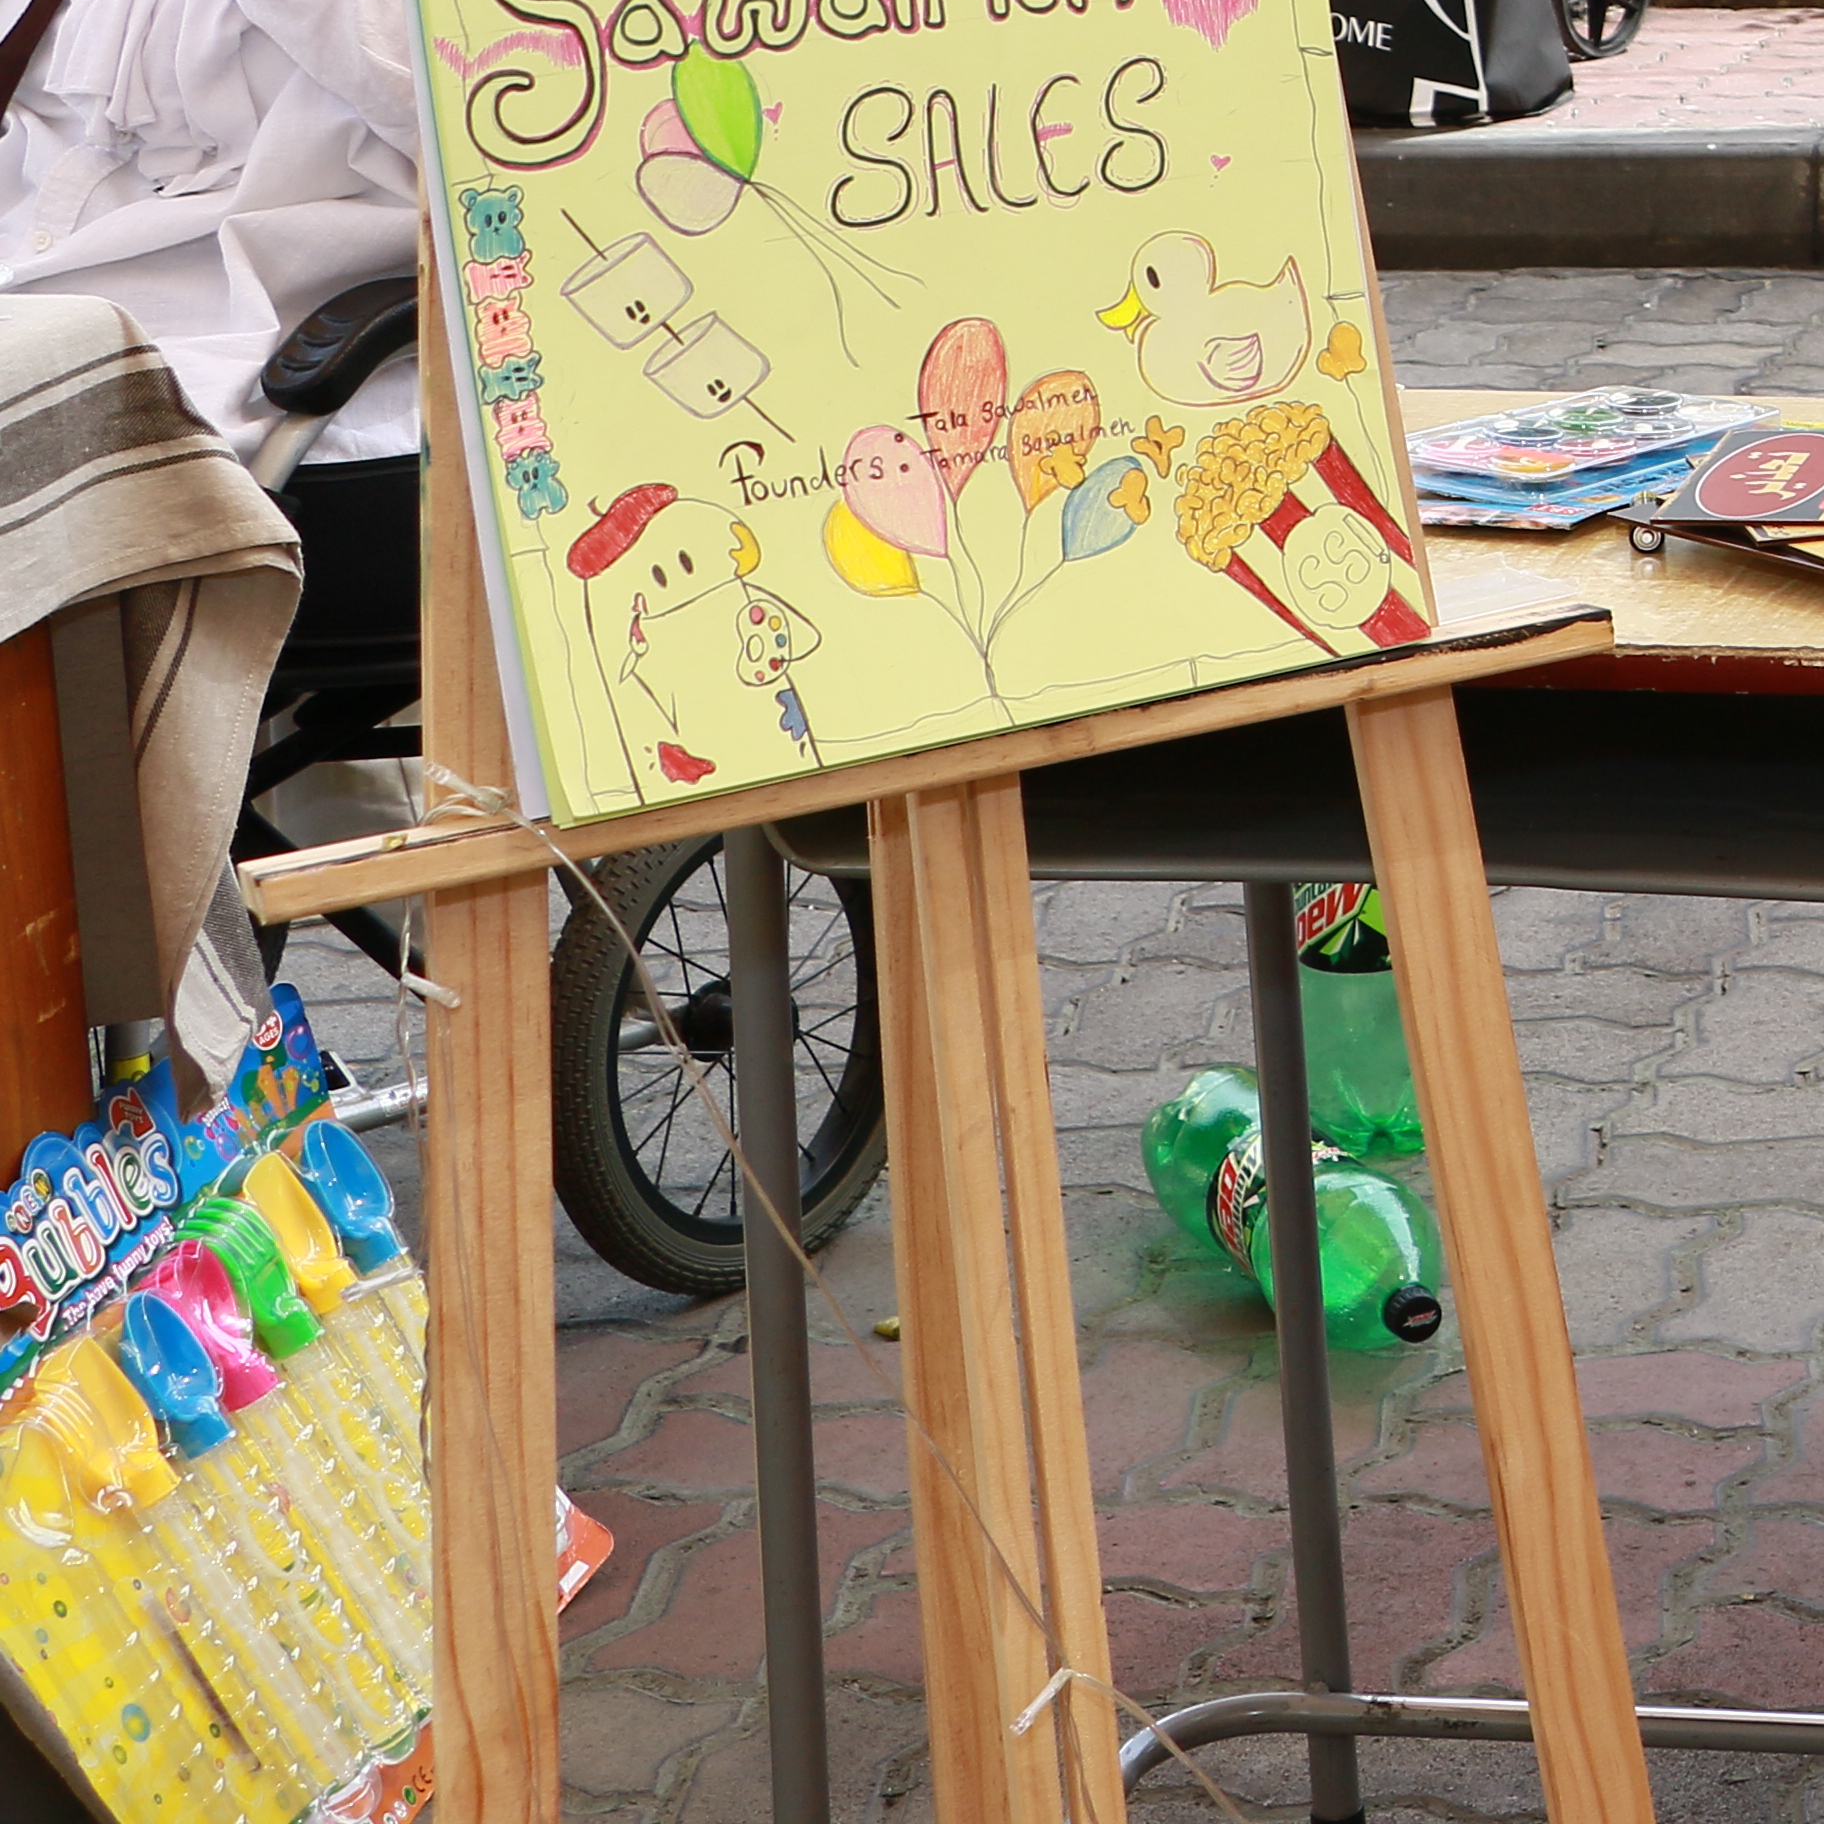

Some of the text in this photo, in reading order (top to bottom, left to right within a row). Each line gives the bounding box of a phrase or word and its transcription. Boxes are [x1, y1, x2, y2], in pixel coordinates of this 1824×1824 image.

[829, 56, 1168, 229] SALES
[907, 410, 969, 433] Tala
[920, 445, 1010, 474] Tamara
[259, 1026, 279, 1046] AGES
[84, 1276, 116, 1305] have
[112, 1243, 148, 1277] funny
[144, 1215, 174, 1245] toys!
